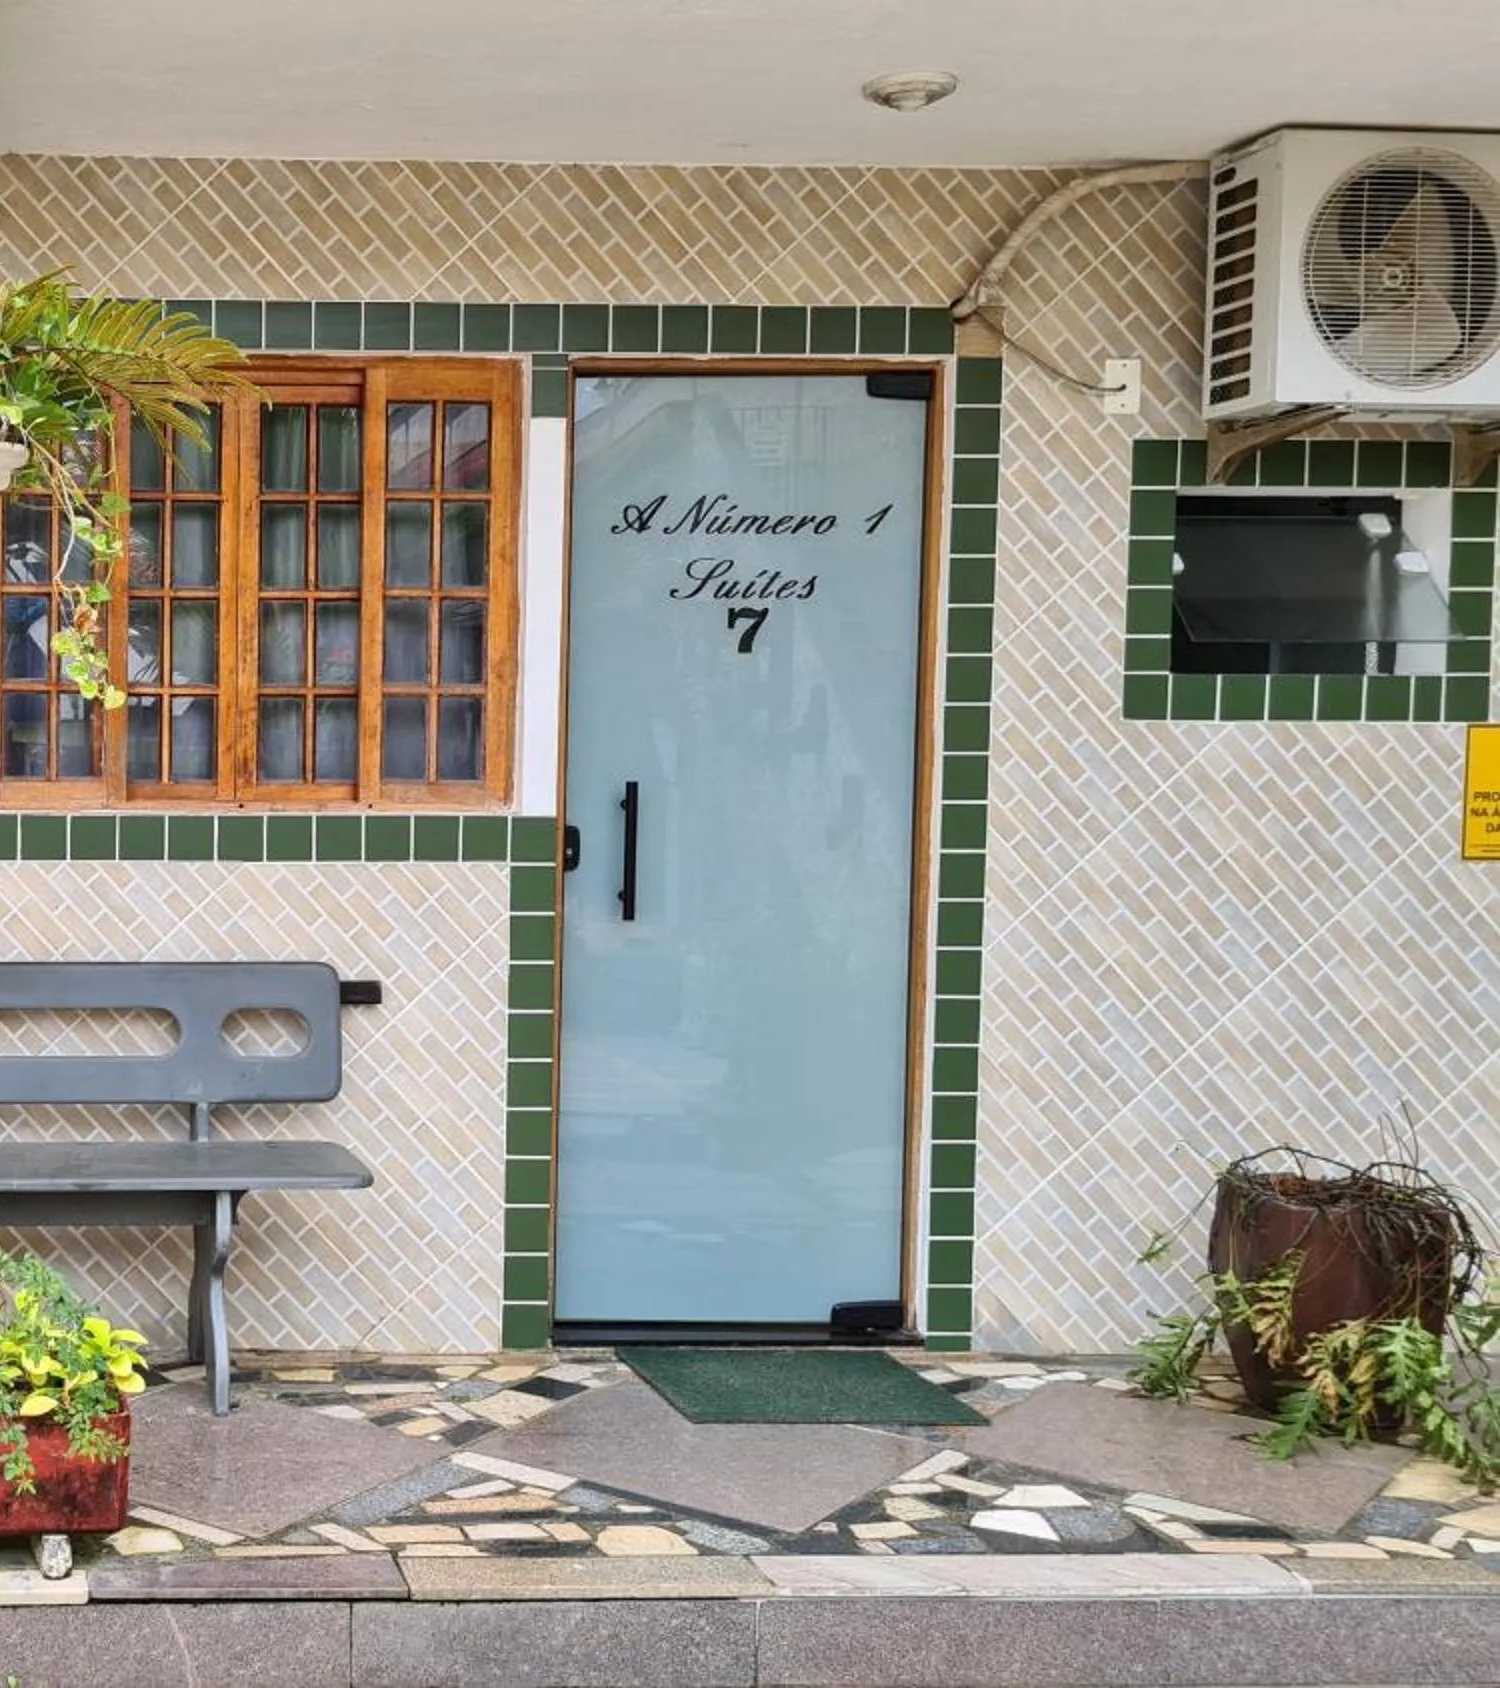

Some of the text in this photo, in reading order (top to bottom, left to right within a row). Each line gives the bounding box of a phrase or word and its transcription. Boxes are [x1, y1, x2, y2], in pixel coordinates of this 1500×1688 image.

[611, 494, 894, 536] A Número 1
[727, 607, 769, 654] 7
